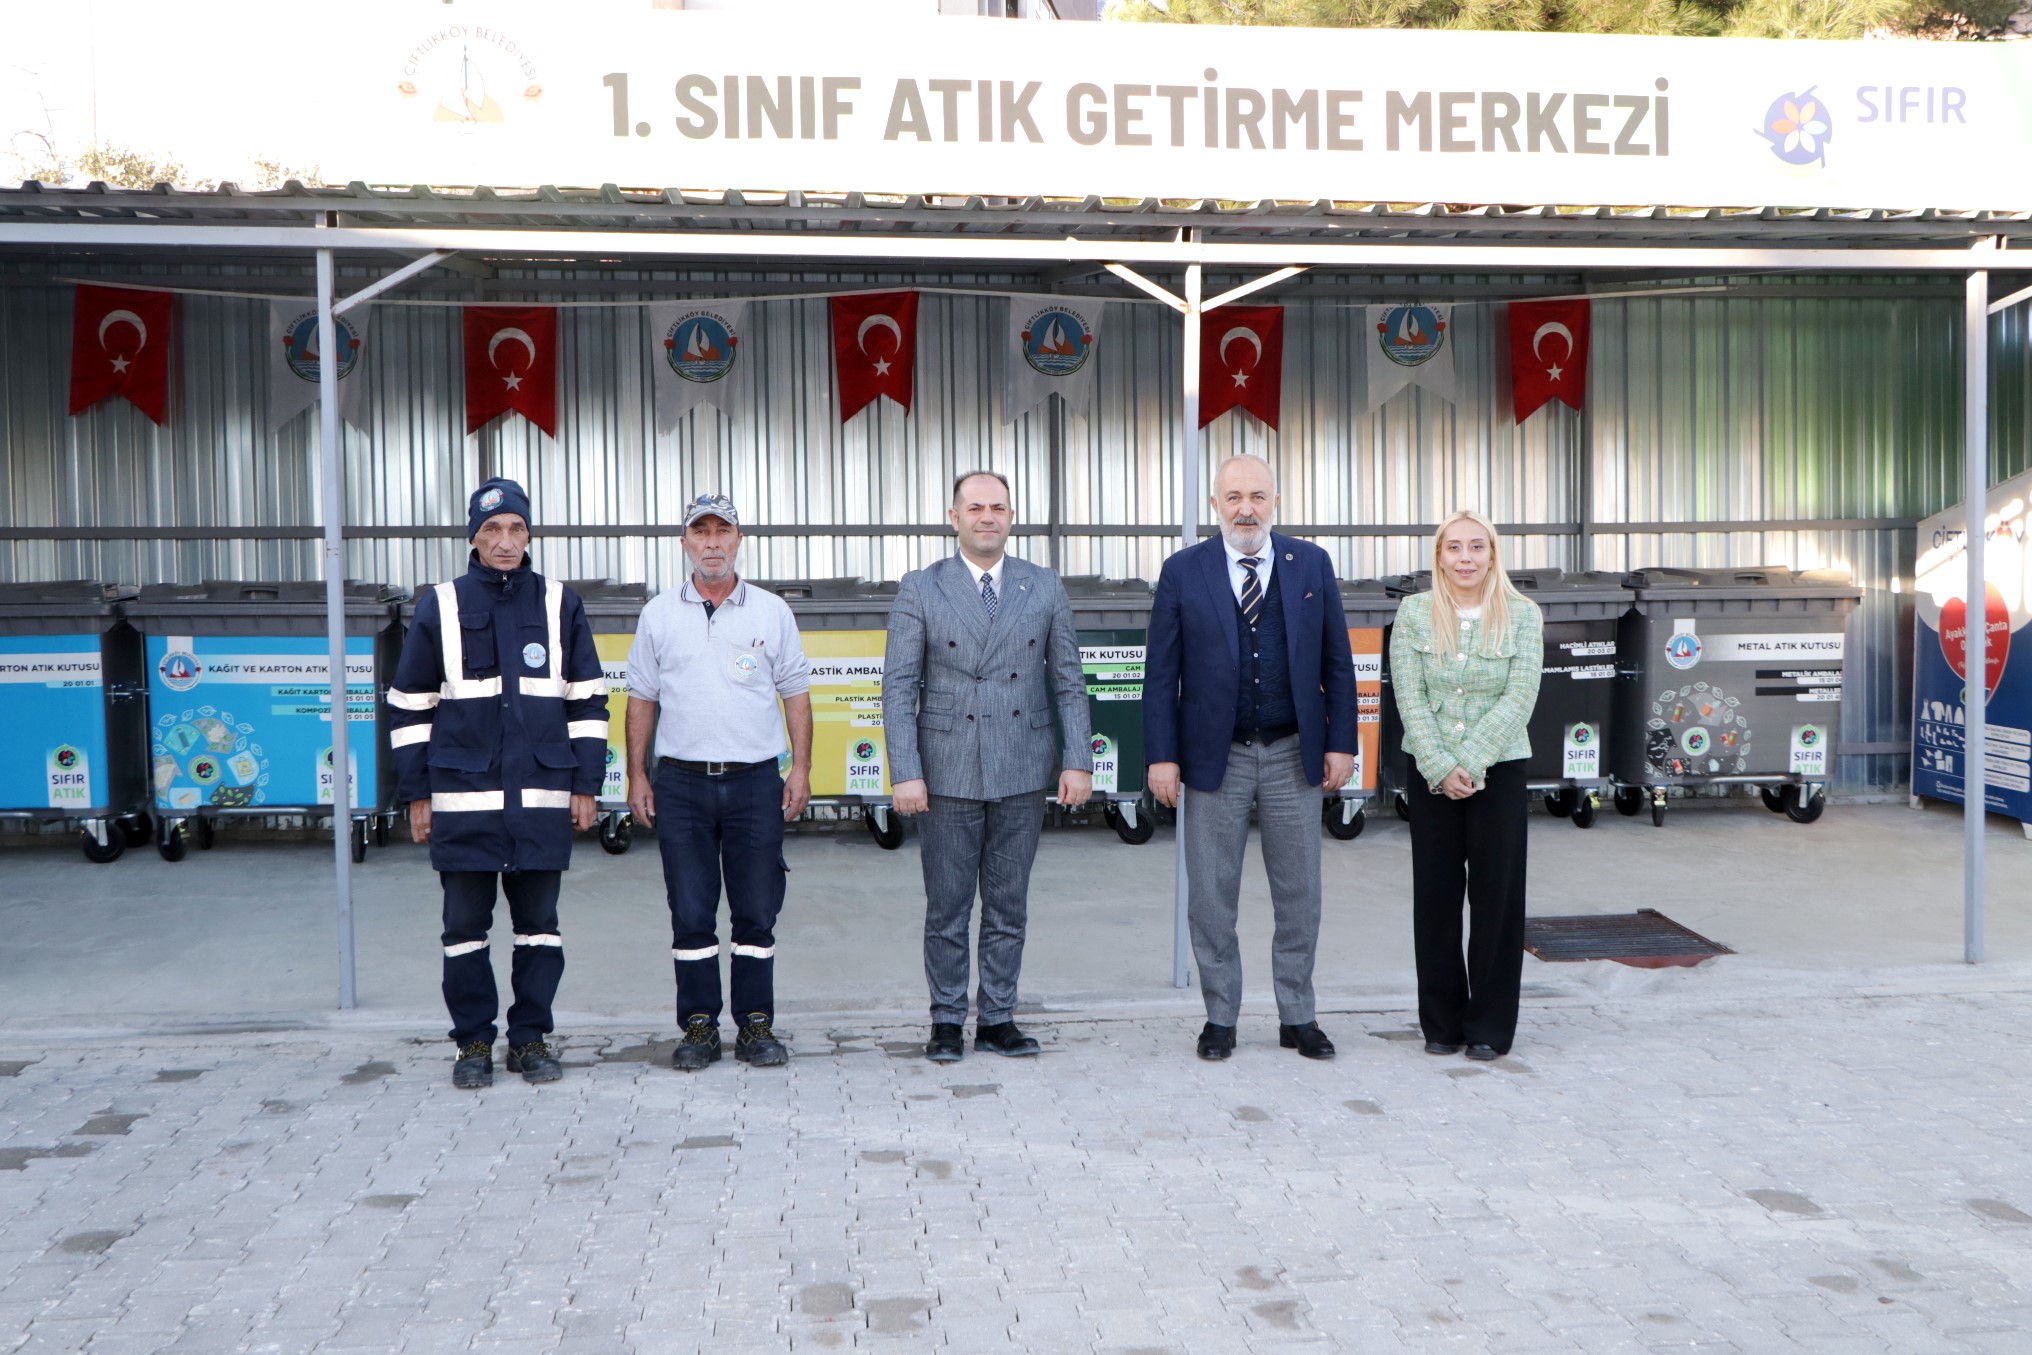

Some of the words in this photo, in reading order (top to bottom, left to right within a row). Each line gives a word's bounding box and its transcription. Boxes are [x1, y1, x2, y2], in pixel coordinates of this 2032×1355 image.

[1856, 85, 1967, 124] SIFIR
[602, 73, 651, 138] 1.
[675, 74, 861, 140] SINIF
[883, 78, 1045, 144] ATIK
[1066, 67, 1364, 152] GETİRME
[1386, 77, 1669, 156] MERKEZİ
[1738, 642, 1772, 650] METAL
[1774, 642, 1798, 650] ATIK
[1800, 642, 1841, 650] KUTUSU
[1080, 651, 1097, 659] TIK
[1100, 650, 1143, 658] KUTUSU
[0, 665, 28, 673] RTON
[32, 664, 54, 672] ATIK
[57, 662, 100, 672] KUTUSU
[208, 664, 240, 673] KAĞIT
[1568, 750, 1596, 760] SIFIR
[1794, 752, 1822, 761] SIFIR
[850, 765, 880, 776] SIFIR
[1093, 762, 1114, 772] FIR
[1568, 762, 1595, 773] ATIK
[1794, 764, 1821, 773] ATIK
[52, 774, 85, 786] SIFIR
[850, 778, 880, 790] ATIK
[1093, 774, 1113, 785] TIK
[52, 787, 86, 800] ATIK
[602, 785, 622, 796] TIK
